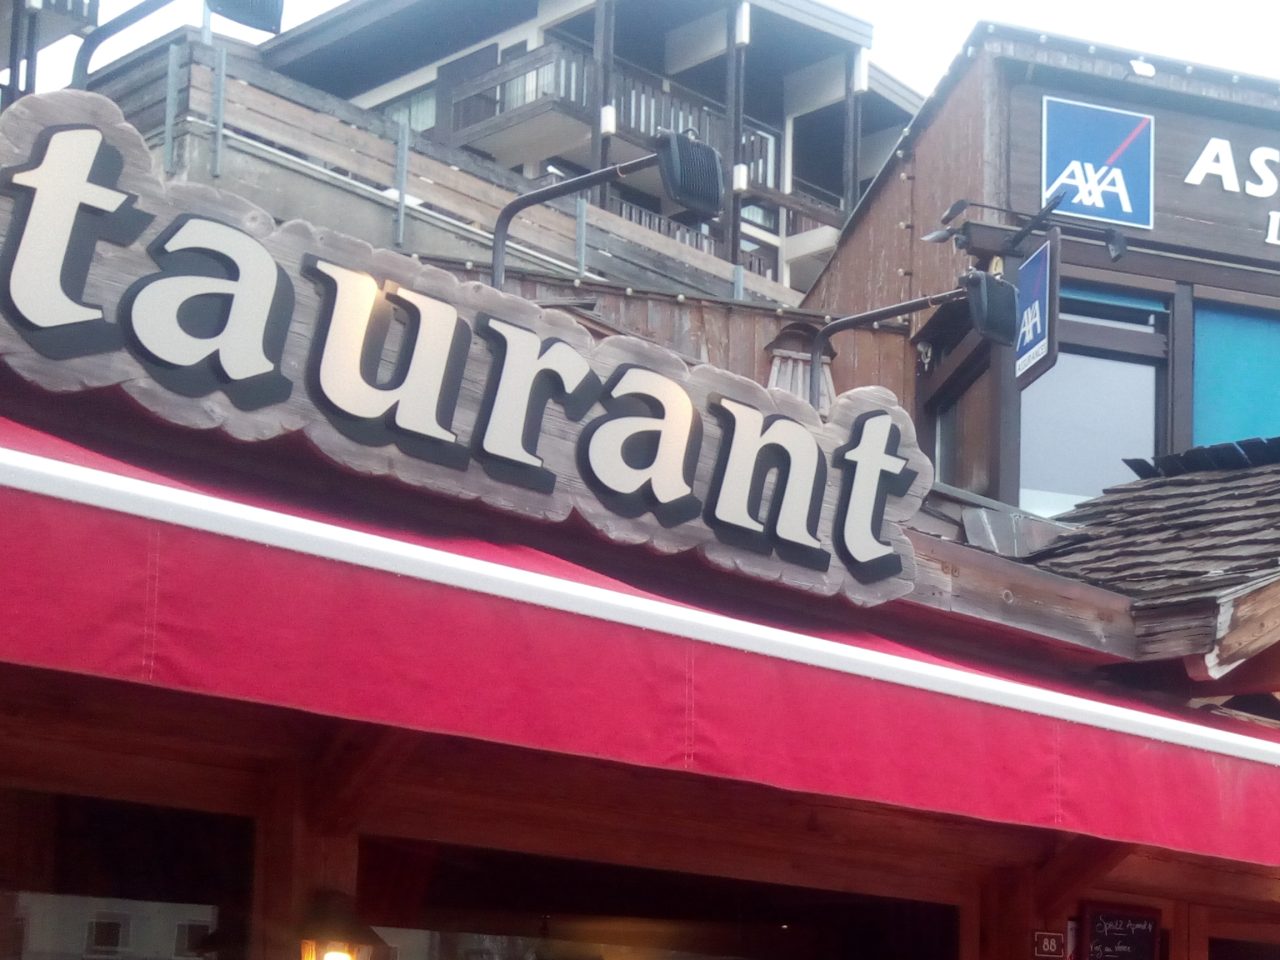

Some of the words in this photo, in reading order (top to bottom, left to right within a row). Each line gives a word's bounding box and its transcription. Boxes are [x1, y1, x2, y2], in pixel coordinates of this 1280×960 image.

[1044, 159, 1133, 213] AXA
[6, 127, 911, 567] taurant
[1016, 299, 1042, 352] AXA
[1042, 937, 1057, 952] 88
